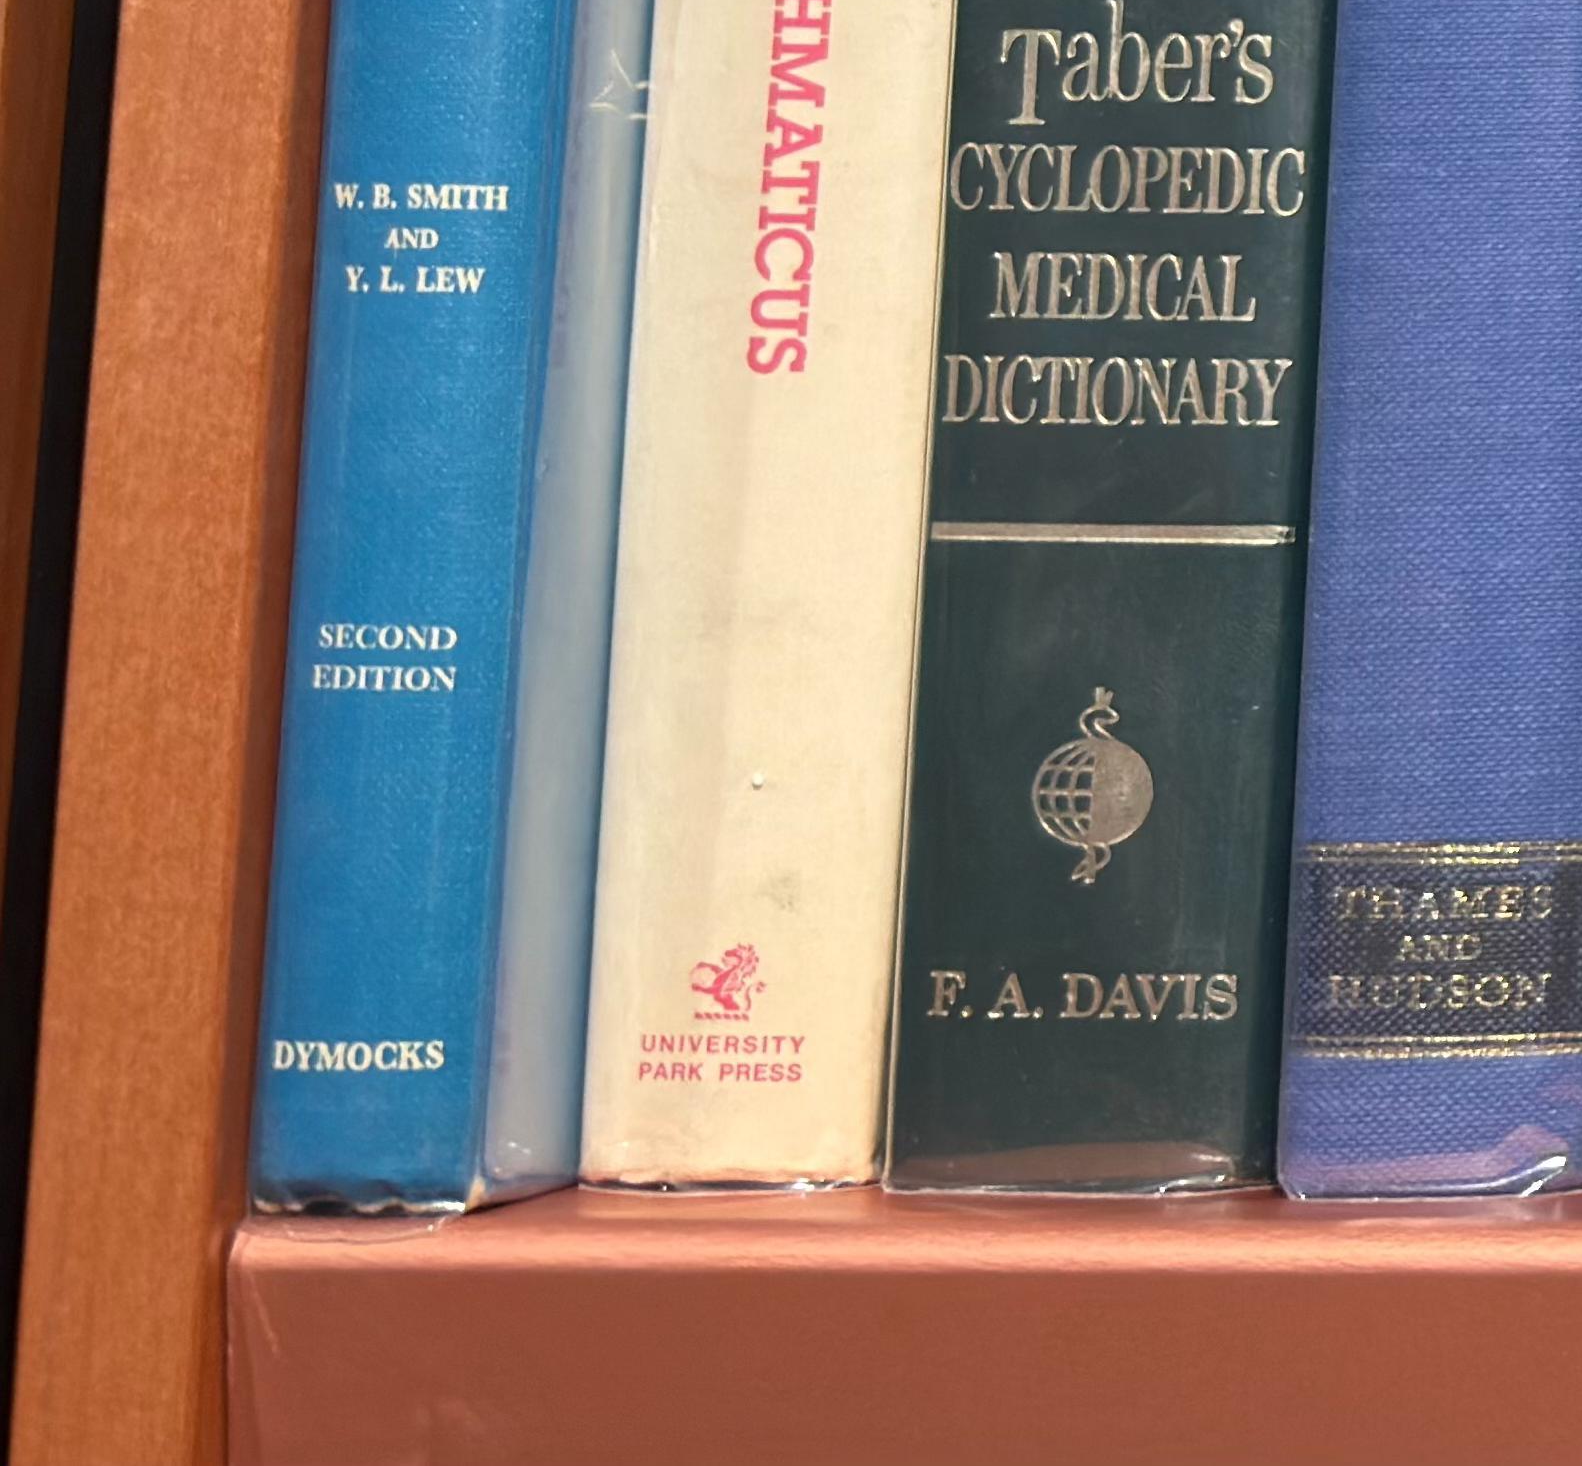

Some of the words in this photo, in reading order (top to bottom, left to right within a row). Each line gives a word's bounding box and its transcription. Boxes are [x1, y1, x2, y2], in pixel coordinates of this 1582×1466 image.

[949, 144, 1306, 216] CYCLOPEDIC
[406, 183, 509, 211] SMITH
[384, 227, 439, 249] AND
[415, 268, 485, 293] LEW
[989, 253, 1257, 321] MEDICAL
[941, 356, 1293, 427] DICTIONARY
[318, 623, 457, 651] SECOND
[311, 664, 456, 692] EDITION
[1060, 974, 1239, 1021] DAVIS
[1329, 973, 1551, 1010] HUDSON
[272, 1039, 445, 1072] DYMOCKS
[640, 1034, 806, 1055] UNIVERSITY
[637, 1062, 709, 1083] PARK
[717, 1062, 803, 1083] PRESS
